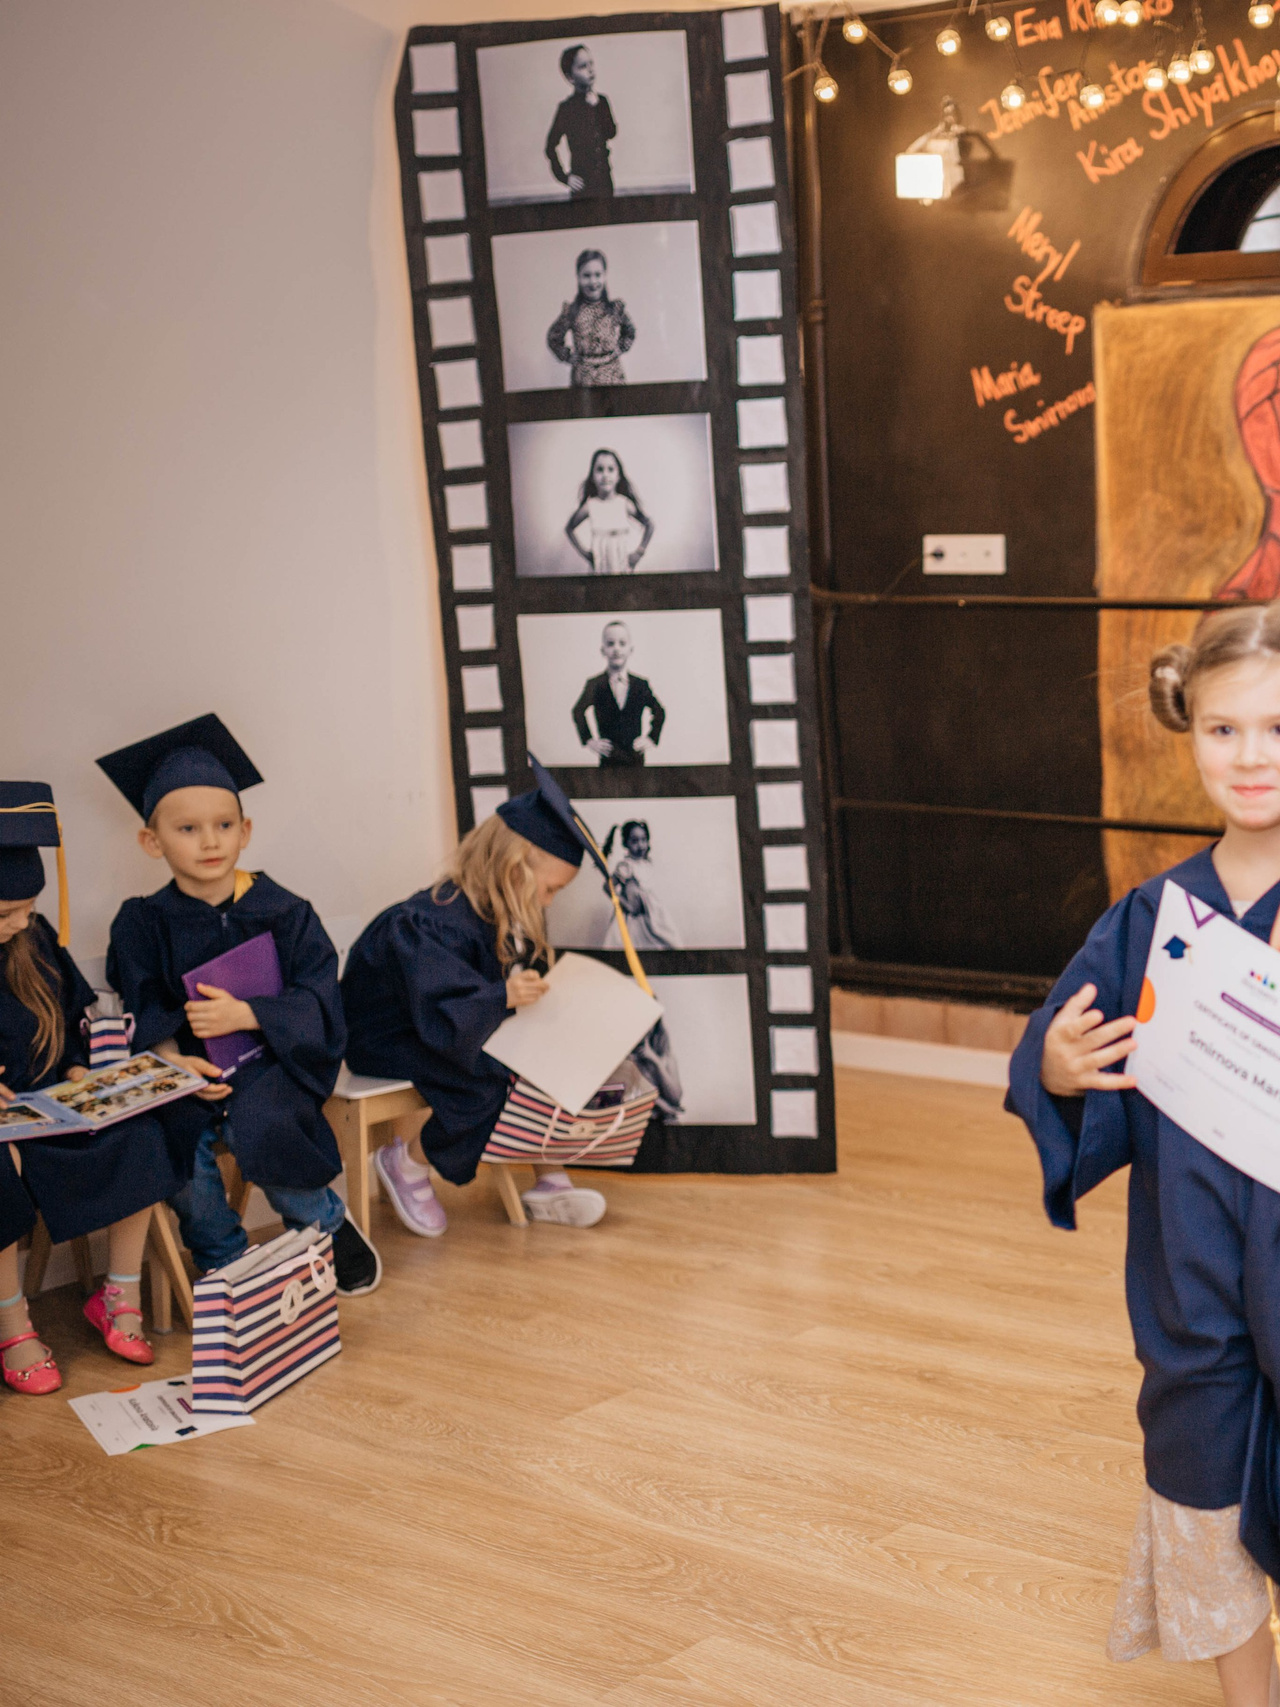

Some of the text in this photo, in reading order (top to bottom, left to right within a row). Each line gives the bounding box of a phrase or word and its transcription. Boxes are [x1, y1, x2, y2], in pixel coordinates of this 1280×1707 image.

[1014, 8, 1063, 47] Eva
[1076, 137, 1144, 184] Kira
[1007, 205, 1081, 288] Meryl
[1004, 275, 1086, 355] Streep
[970, 361, 1042, 408] Maria
[1189, 1030, 1249, 1082] Smirnova
